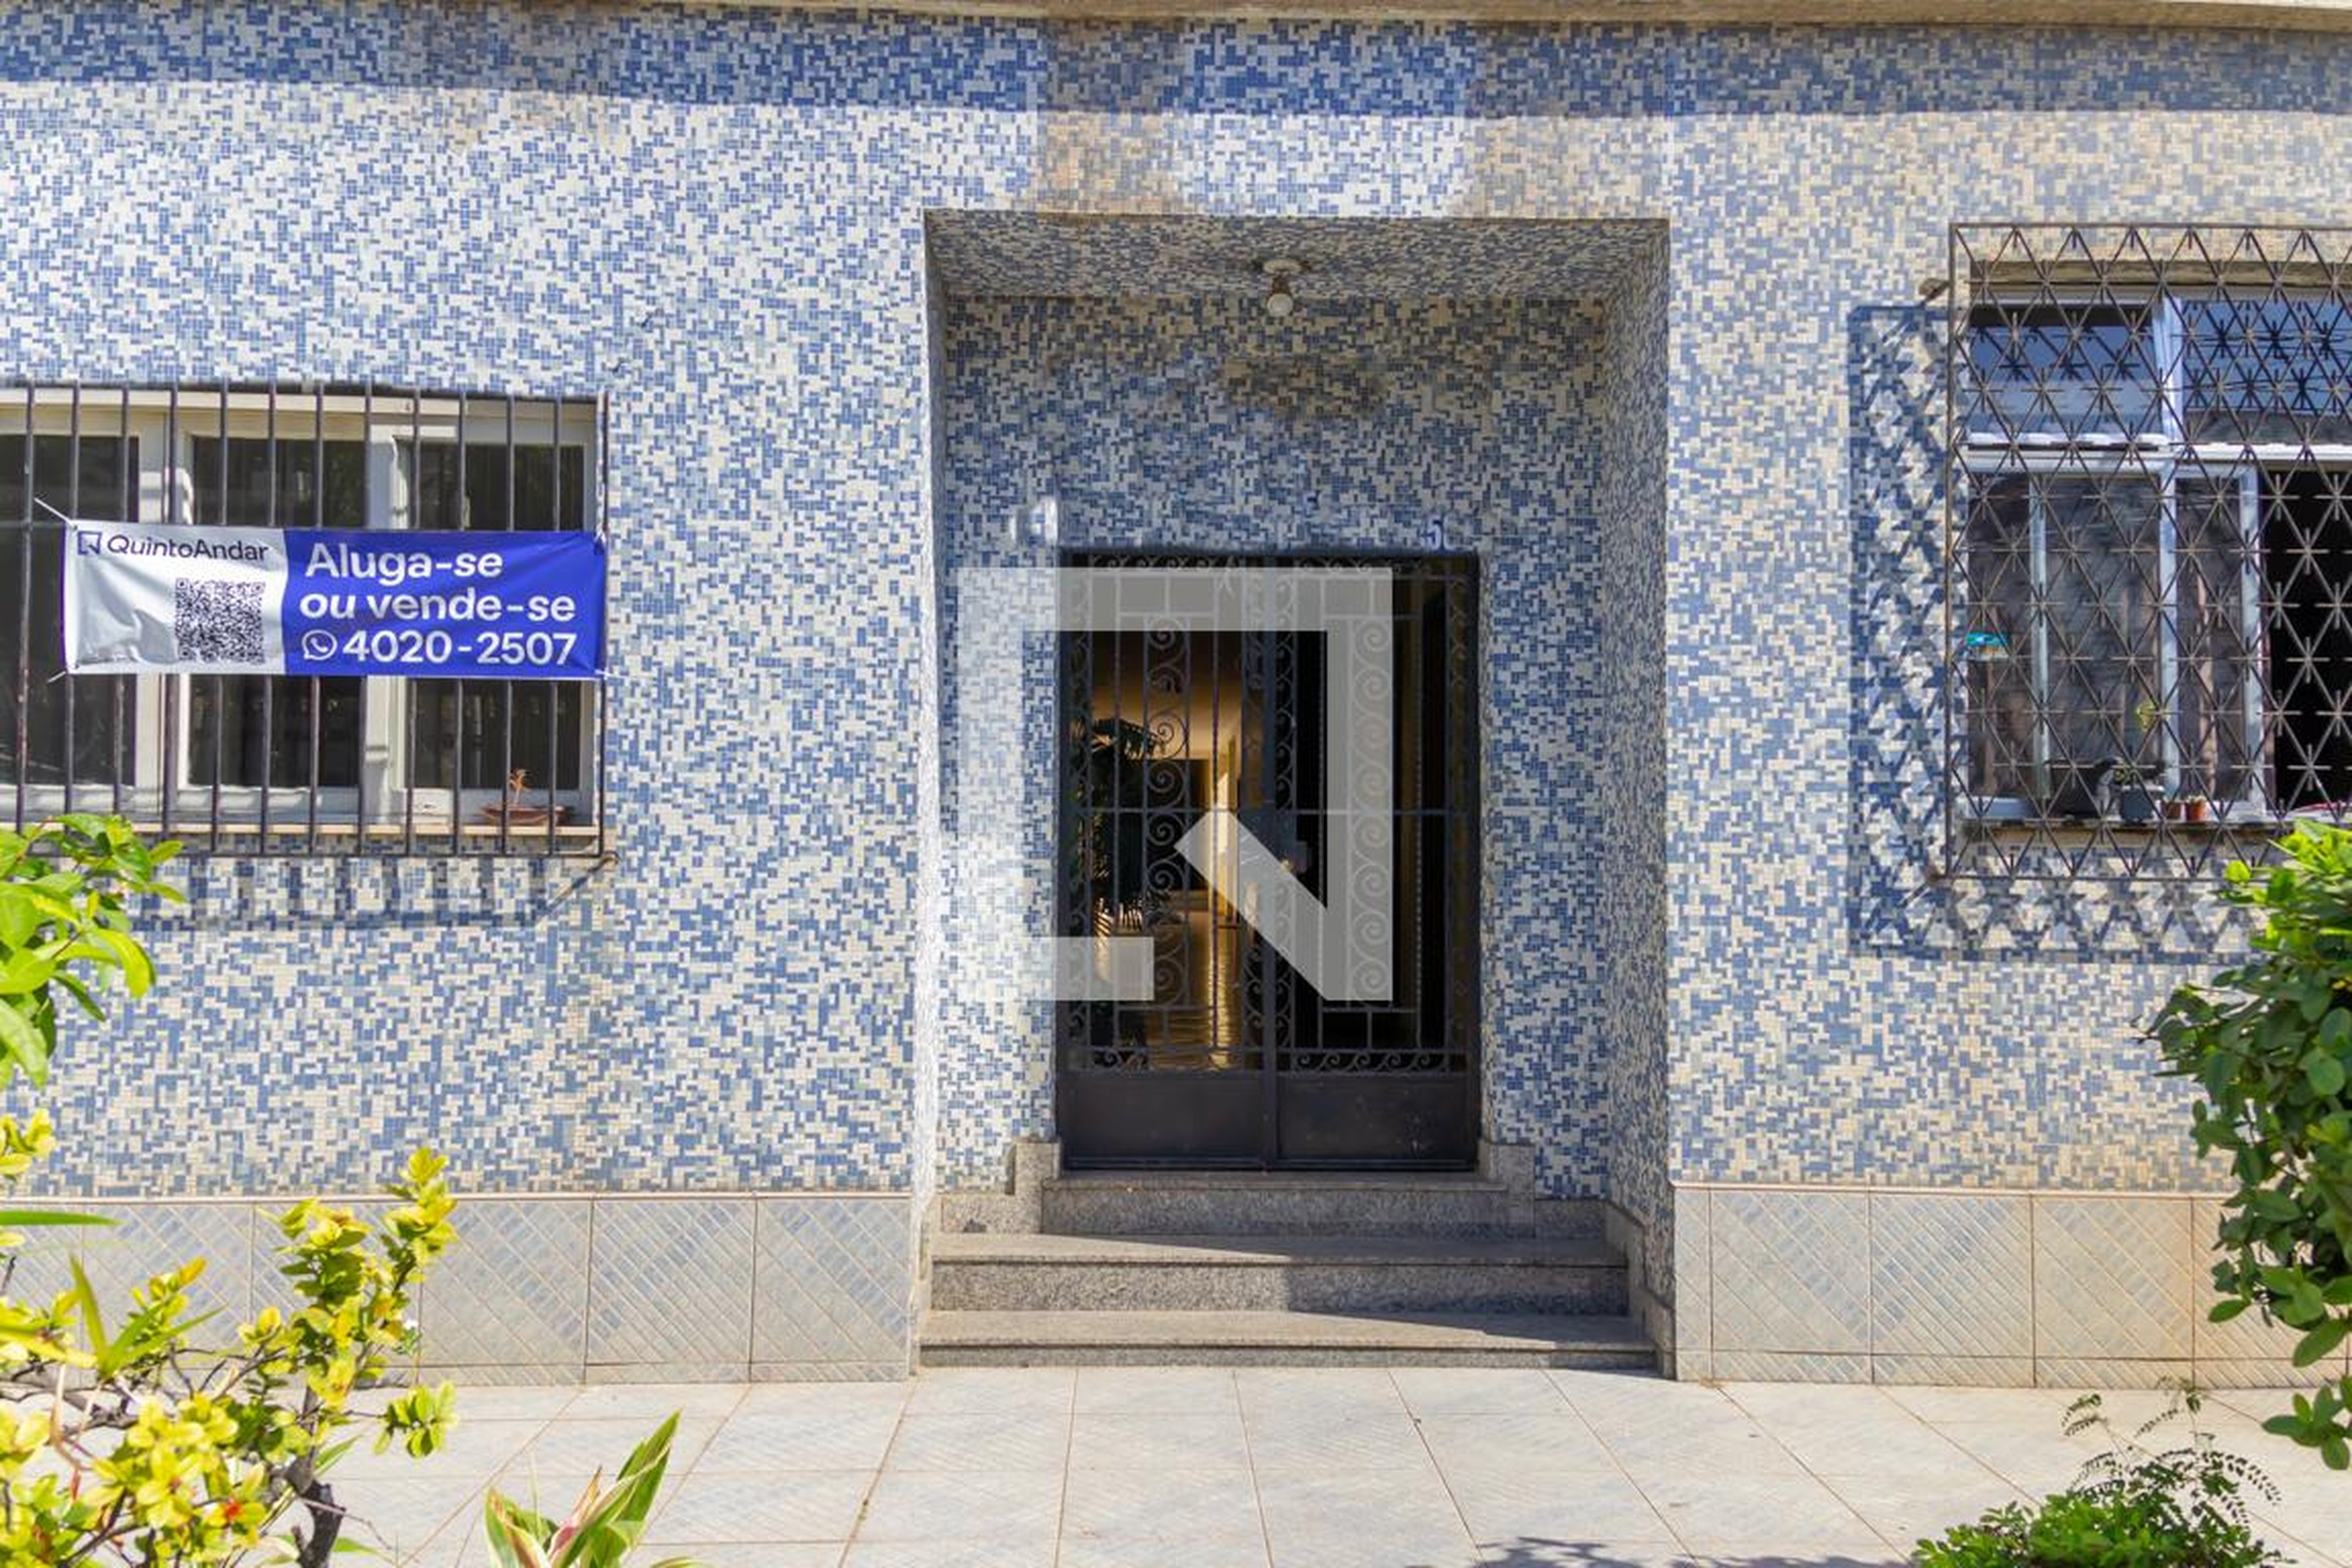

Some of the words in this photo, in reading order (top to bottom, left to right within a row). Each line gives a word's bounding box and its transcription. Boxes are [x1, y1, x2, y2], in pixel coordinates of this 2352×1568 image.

[107, 534, 269, 561] QuintoAndar
[306, 542, 503, 586] Aluga-se
[299, 592, 356, 619] ou
[366, 586, 576, 622] vende-se
[342, 630, 578, 665] 4020-2507
